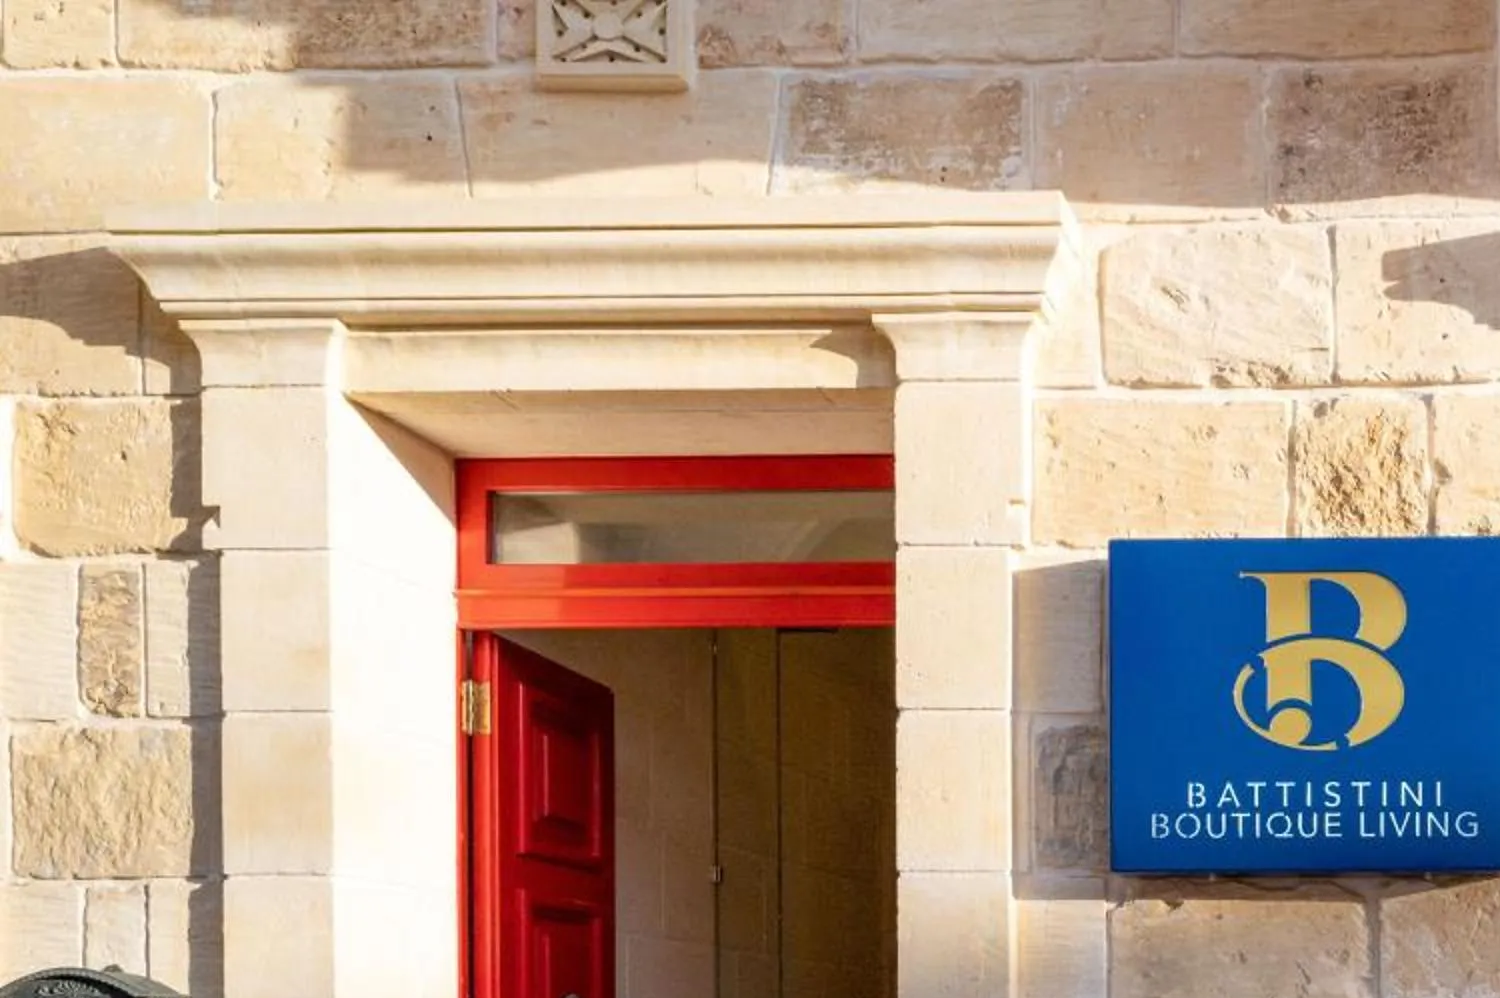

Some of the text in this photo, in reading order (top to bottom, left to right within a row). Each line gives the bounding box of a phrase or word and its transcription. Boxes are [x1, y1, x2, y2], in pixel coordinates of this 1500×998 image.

[1187, 781, 1442, 808] BATTISTINI
[1151, 811, 1479, 839] BOUTIQUE LIVING
